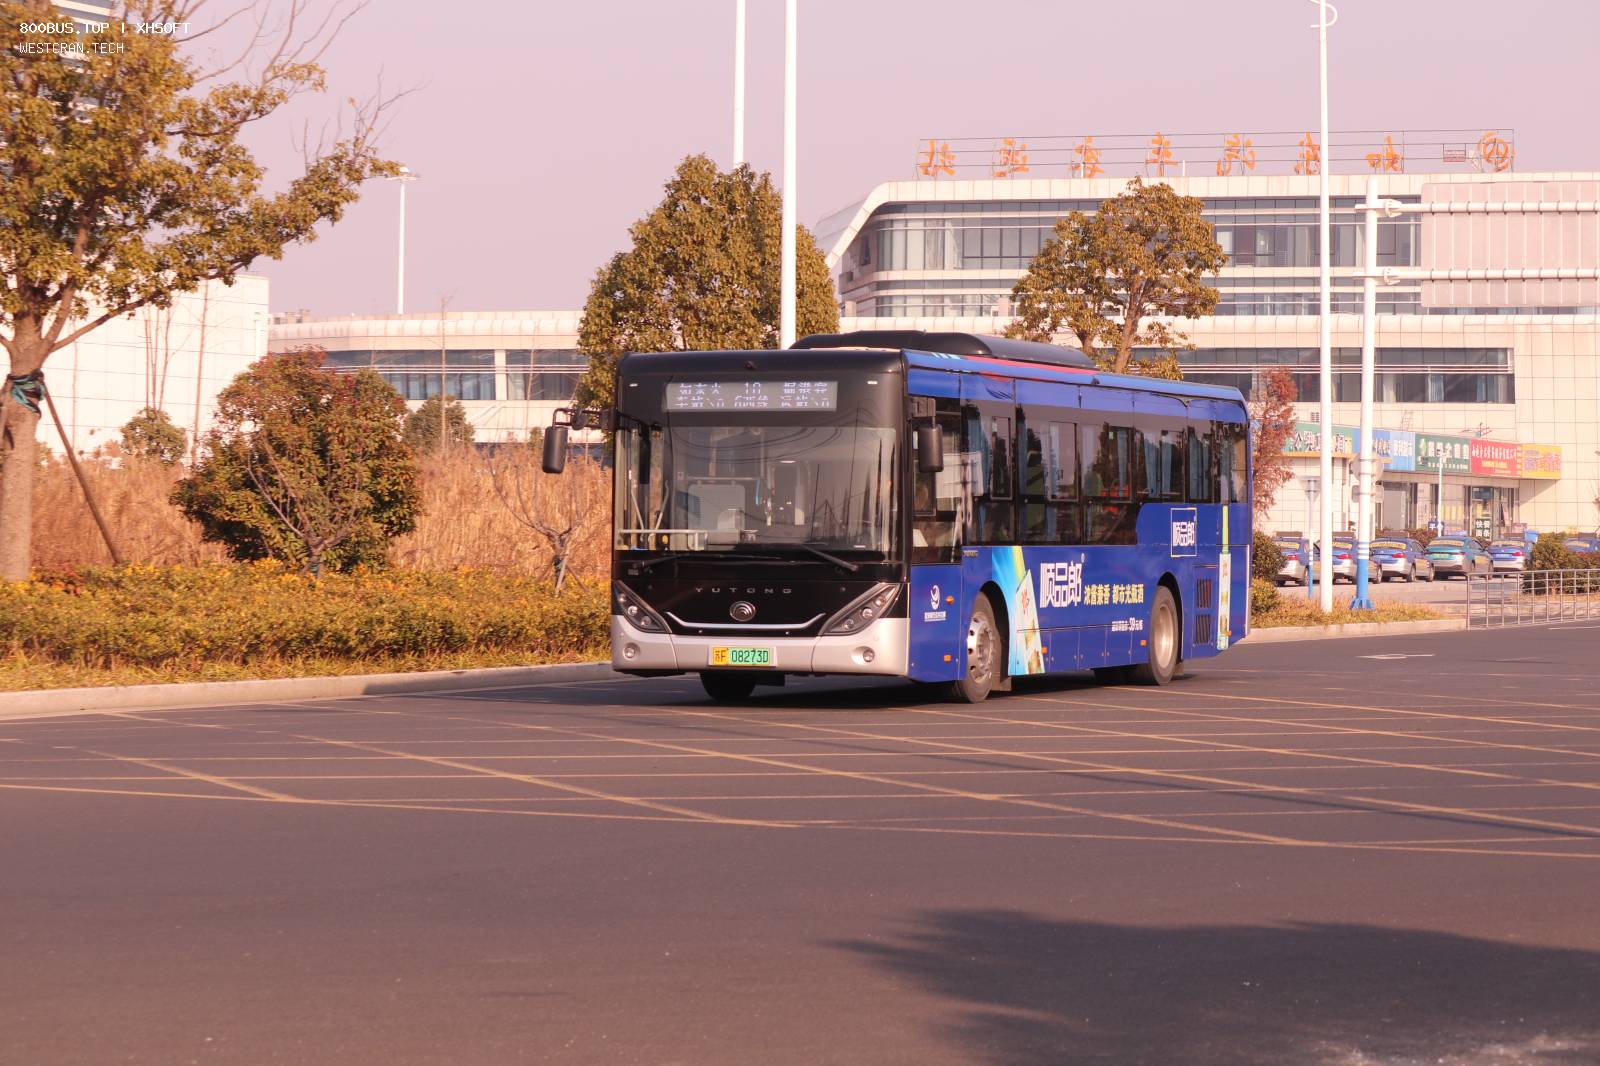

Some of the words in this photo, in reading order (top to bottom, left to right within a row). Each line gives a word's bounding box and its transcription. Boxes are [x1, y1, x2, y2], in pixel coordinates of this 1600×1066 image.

[1172, 520, 1195, 546] 顺品郎
[1039, 560, 1082, 608] 顺品郎
[731, 649, 768, 662] 08273D
